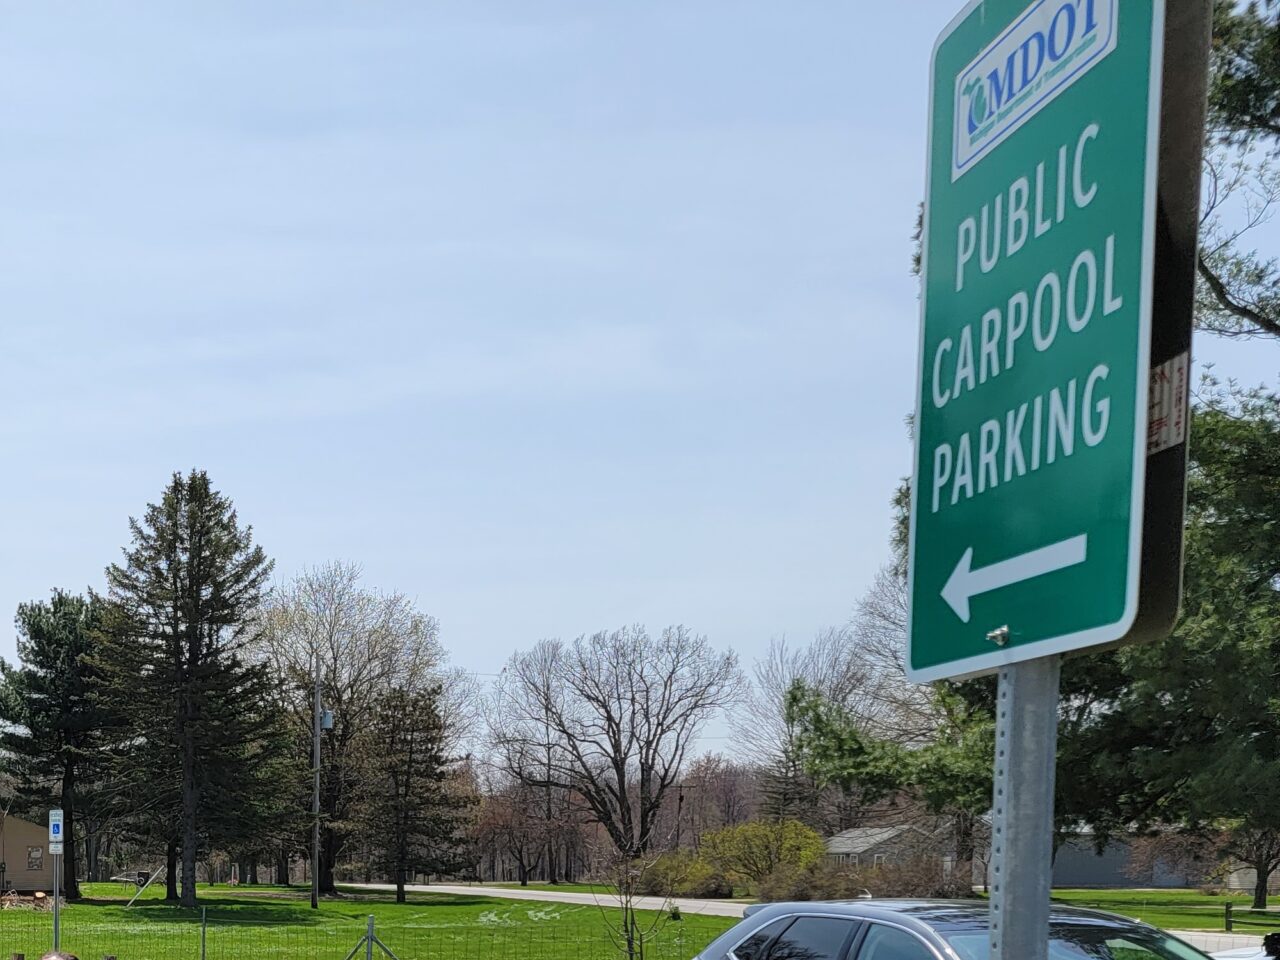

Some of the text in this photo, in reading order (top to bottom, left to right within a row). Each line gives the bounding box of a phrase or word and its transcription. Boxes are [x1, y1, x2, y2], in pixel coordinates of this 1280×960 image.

[986, 0, 1098, 120] MDOT
[955, 123, 1100, 292] PUBLIC
[932, 232, 1123, 409] CARPOOL
[931, 363, 1111, 514] PARKING
